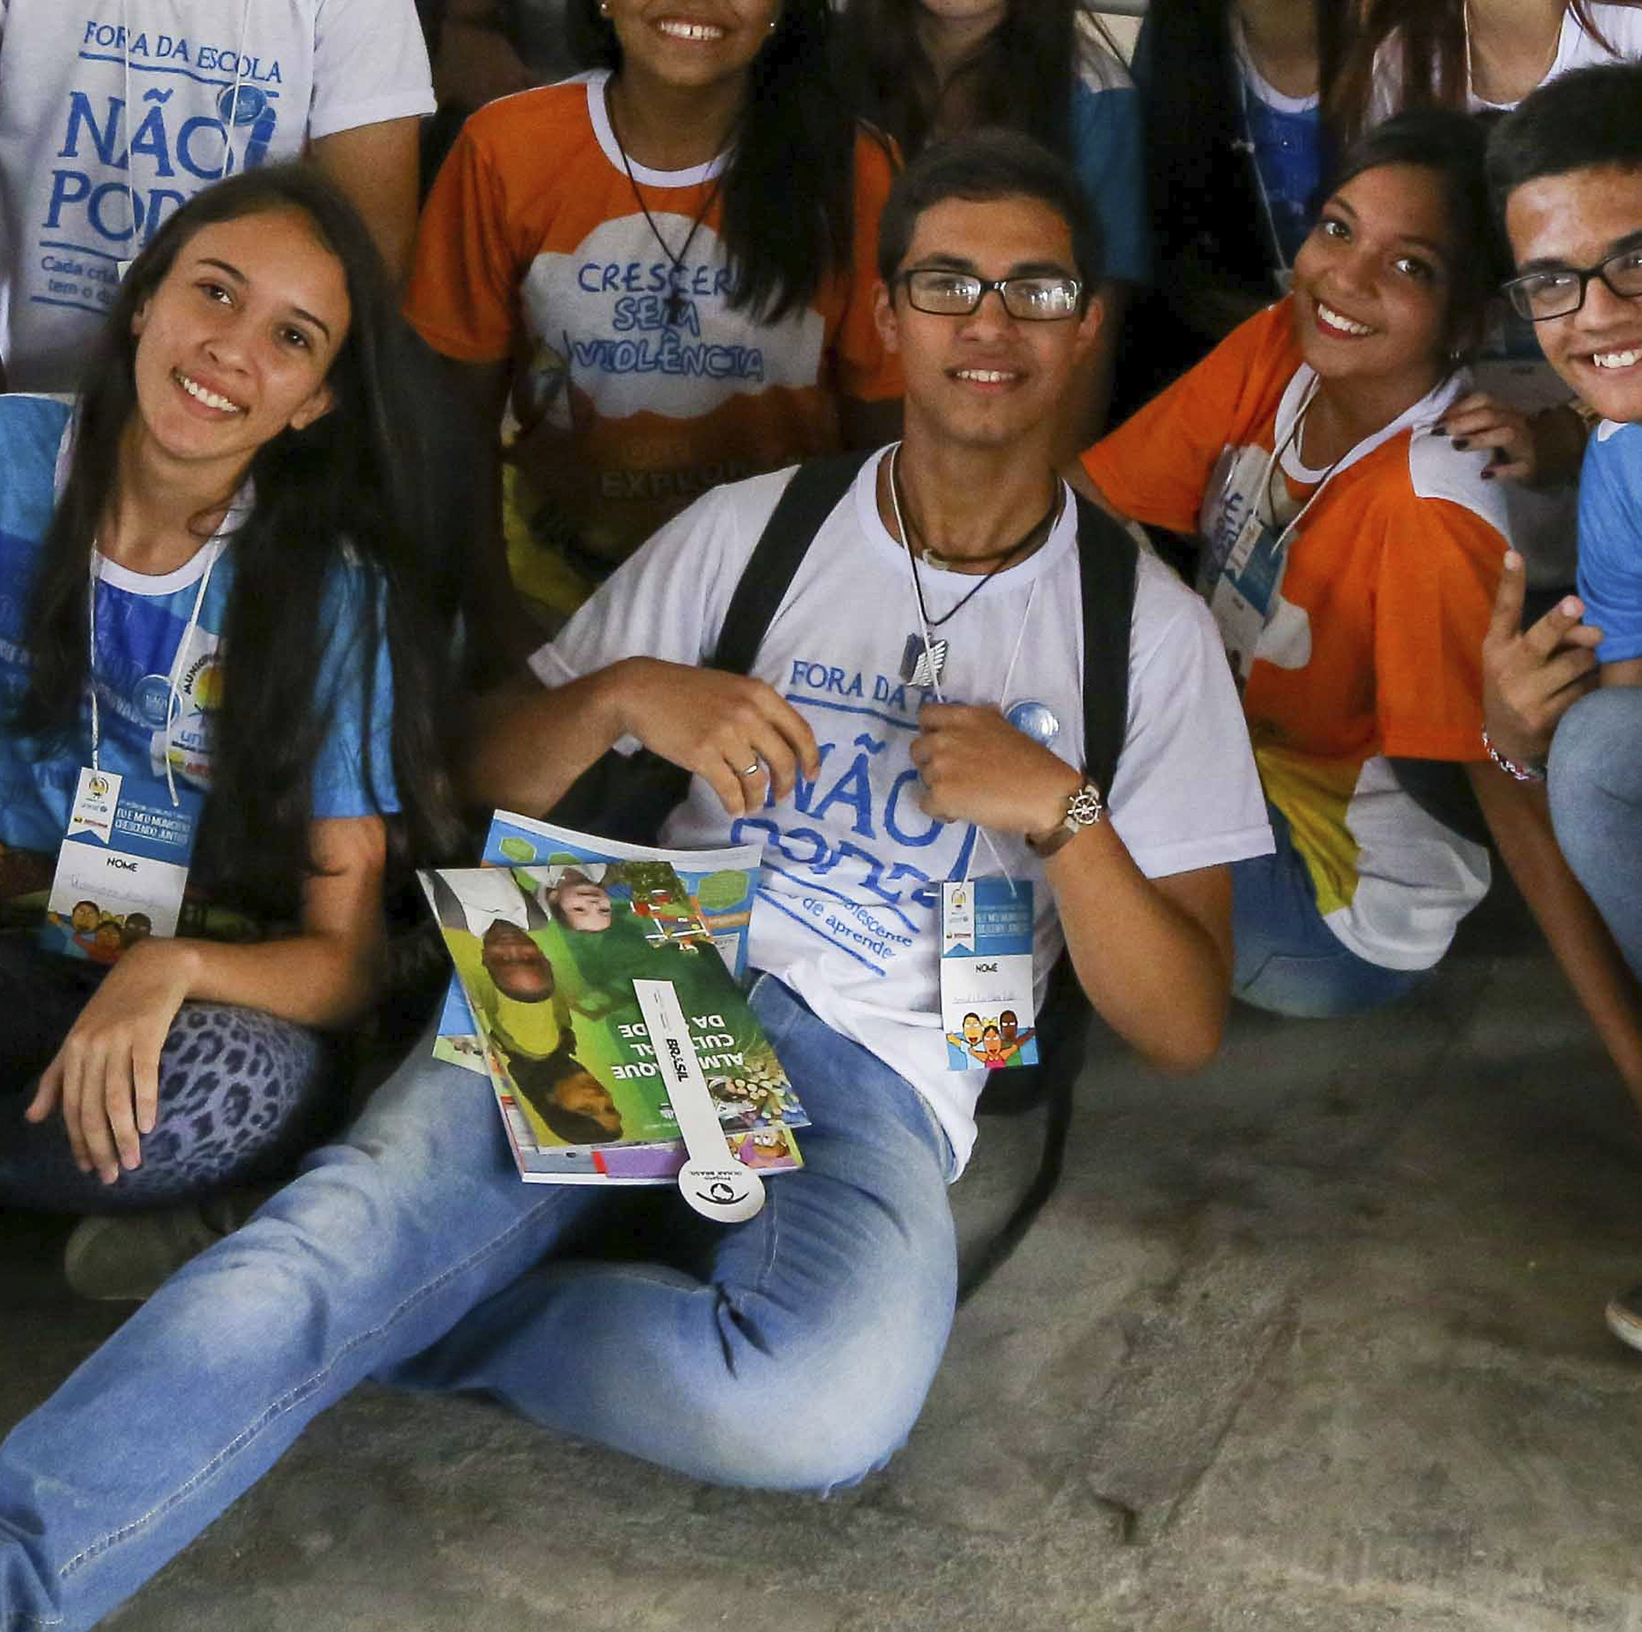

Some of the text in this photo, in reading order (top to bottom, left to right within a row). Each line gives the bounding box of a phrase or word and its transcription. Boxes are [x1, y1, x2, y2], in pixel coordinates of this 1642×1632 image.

[83, 20, 282, 84] FORA DA ESCOLA
[58, 87, 235, 182] NÃO
[43, 169, 198, 248] POD
[578, 261, 733, 297] CRESCER
[612, 295, 702, 338] SEM
[563, 330, 766, 382] VIOLÊNCIA
[790, 660, 864, 698] FORA
[873, 677, 907, 710] DA
[107, 857, 139, 872] NOME
[975, 962, 998, 973] NOME
[691, 1014, 727, 1029] DA
